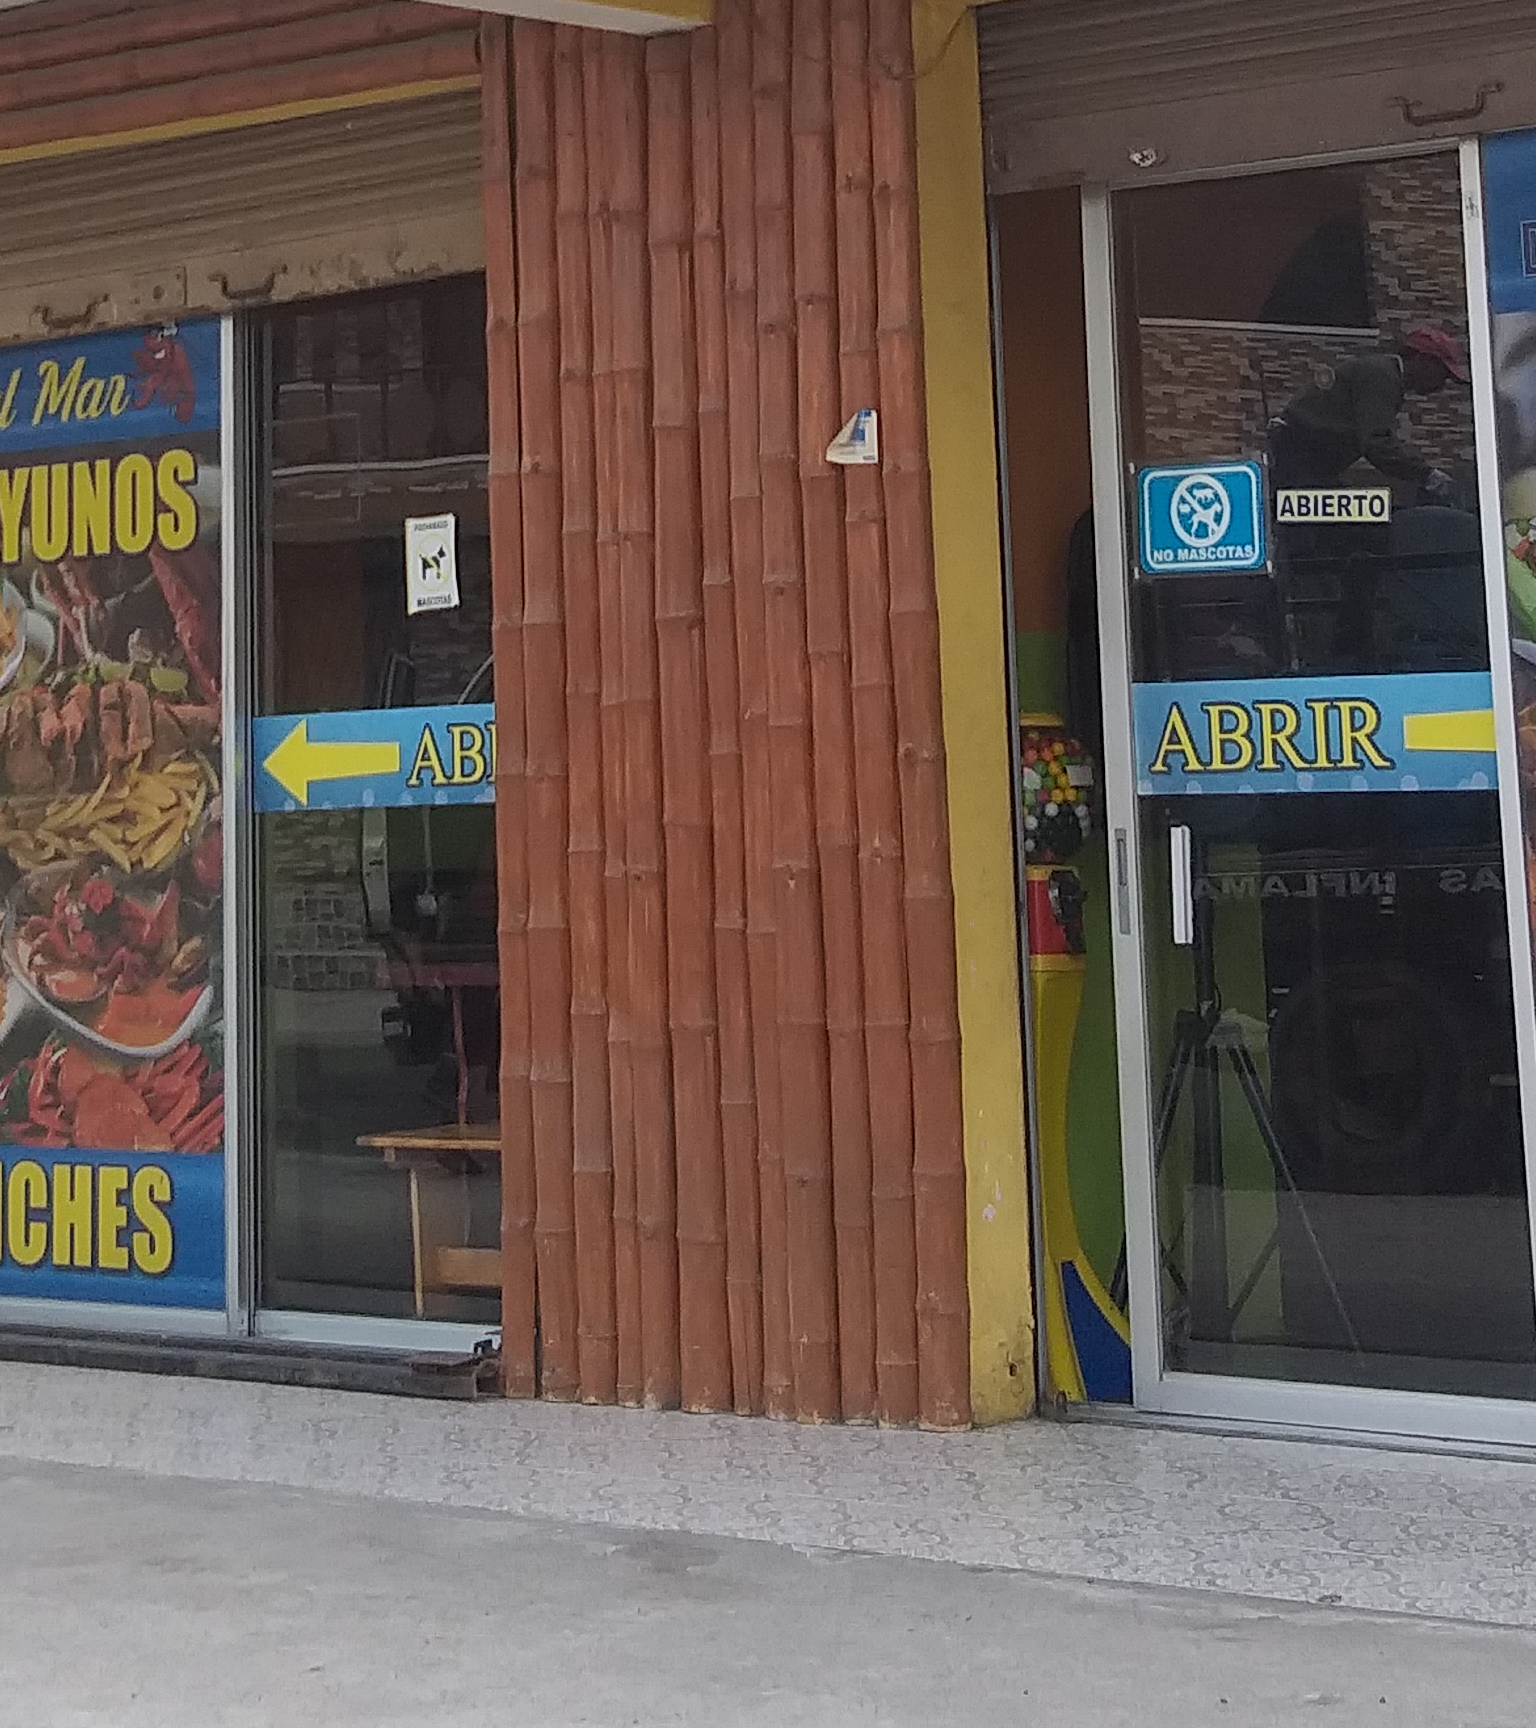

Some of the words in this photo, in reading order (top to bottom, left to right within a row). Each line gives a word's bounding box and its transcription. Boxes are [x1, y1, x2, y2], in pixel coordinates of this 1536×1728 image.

[32, 357, 131, 427] Mar
[1280, 495, 1385, 518] ABIERTO
[1152, 548, 1174, 563] NO
[1177, 545, 1253, 562] MASCOTAS
[1149, 696, 1396, 775] ABRIR
